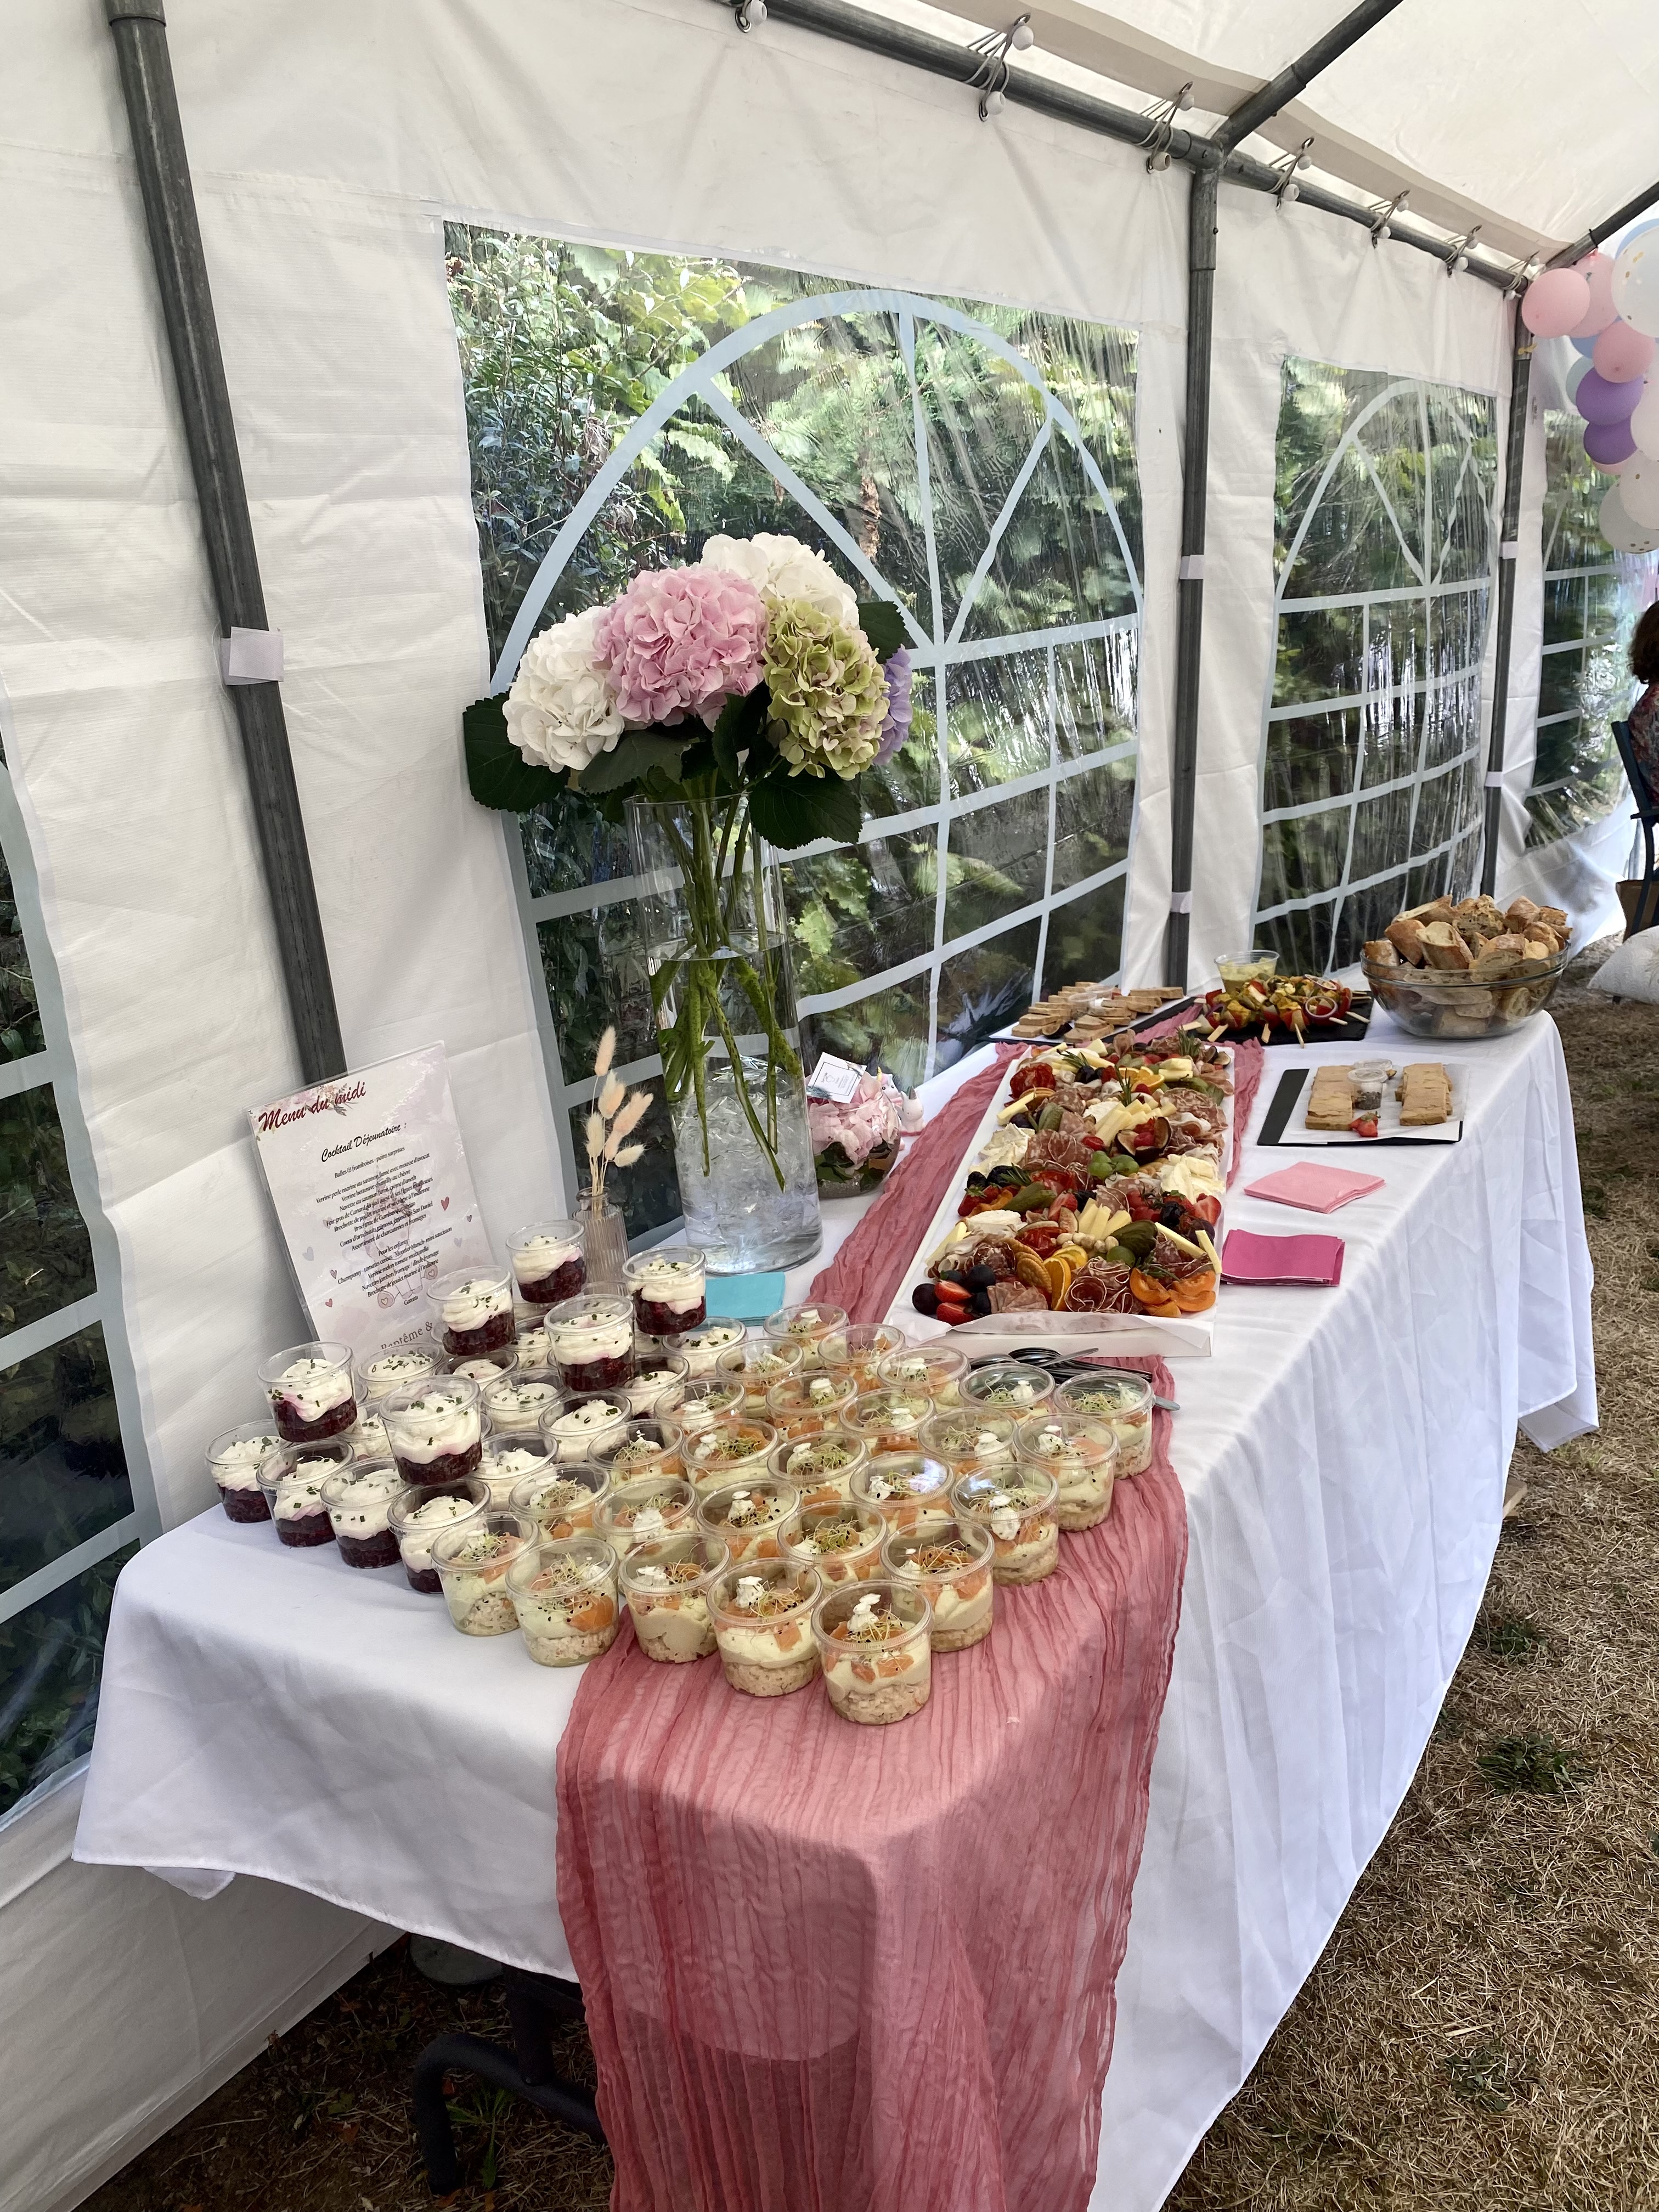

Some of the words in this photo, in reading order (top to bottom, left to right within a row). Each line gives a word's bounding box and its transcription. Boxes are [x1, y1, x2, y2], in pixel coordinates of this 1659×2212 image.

[258, 1107, 306, 1132] Menu
[311, 1095, 330, 1114] du
[334, 1081, 366, 1105] midi
[321, 1141, 352, 1162] Cocktail
[354, 1124, 401, 1148] Déjeunatoire
[352, 1159, 374, 1171] framboises
[376, 1154, 387, 1163] pains
[388, 1147, 405, 1156] surprises
[316, 1194, 331, 1203] Verrine
[331, 1189, 341, 1199] perle
[342, 1184, 356, 1193] marine
[363, 1175, 379, 1184] saumon
[399, 1160, 413, 1169] mousse
[414, 1153, 430, 1163] d'avocat
[341, 1193, 356, 1201] Verrine
[356, 1185, 374, 1195] betterave
[398, 1170, 410, 1178] chèvre
[340, 1202, 356, 1211] Navette
[335, 1215, 345, 1223] gras
[334, 1220, 353, 1232] Brochette
[352, 1237, 375, 1250] Assortiment
[338, 1271, 360, 1284] Champomy
[425, 1322, 432, 1331] &
